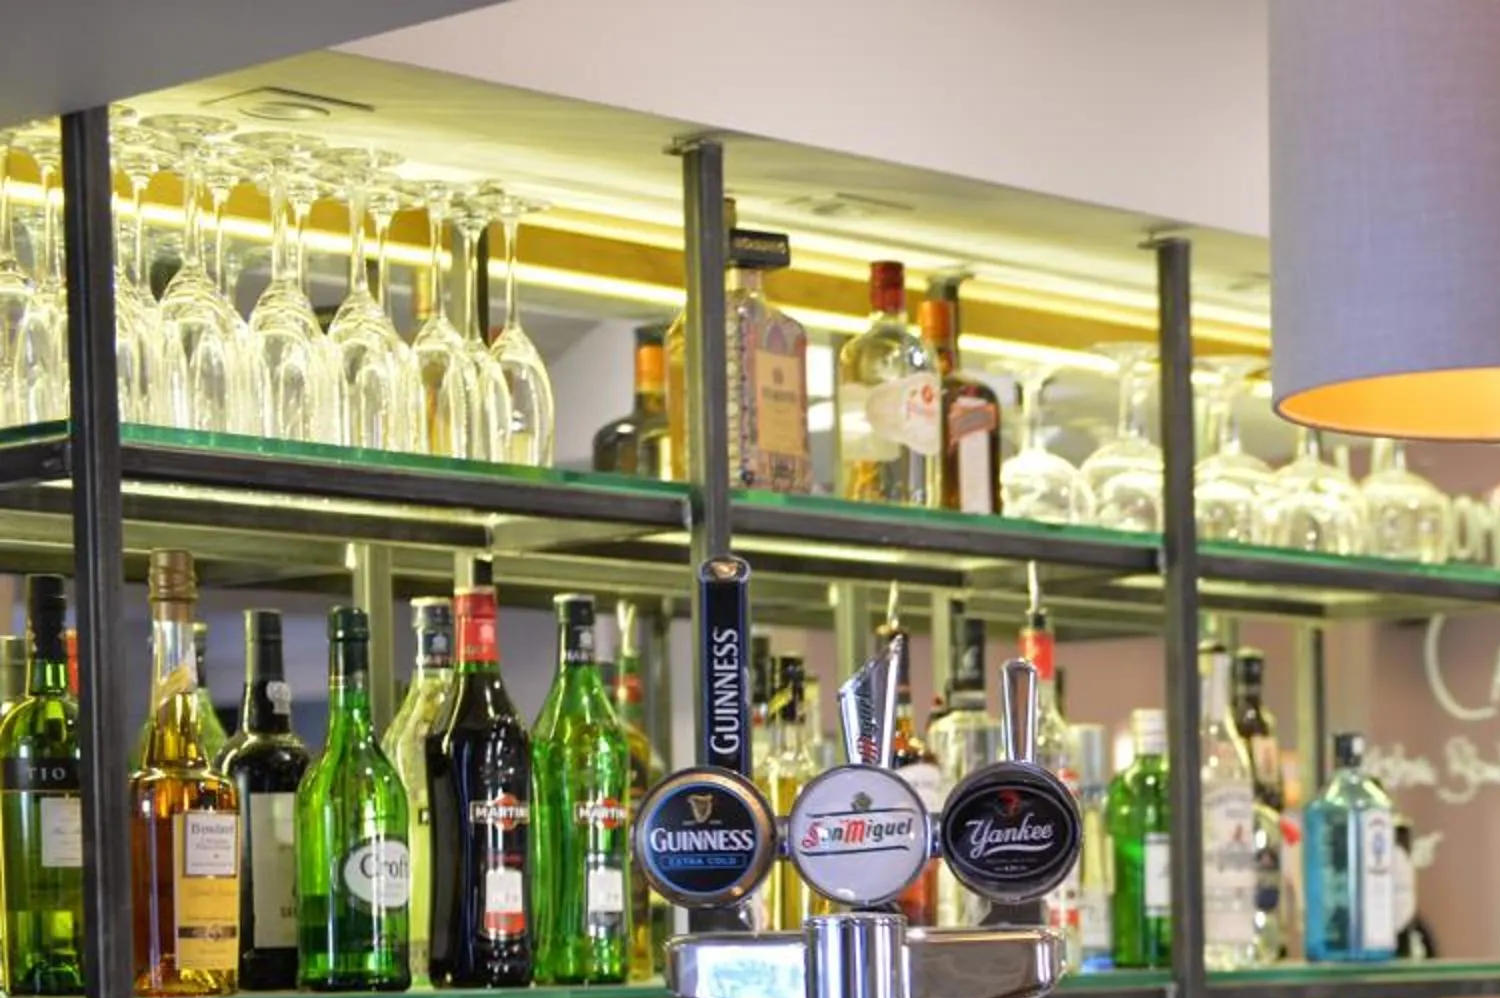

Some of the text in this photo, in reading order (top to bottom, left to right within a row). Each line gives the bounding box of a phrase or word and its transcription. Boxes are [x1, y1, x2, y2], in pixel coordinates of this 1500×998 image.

[710, 627, 740, 754] GUINNESS
[27, 767, 67, 781] TIO
[650, 827, 755, 853] GUINNESS
[843, 818, 913, 844] Miguel
[965, 812, 1054, 859] Yankee
